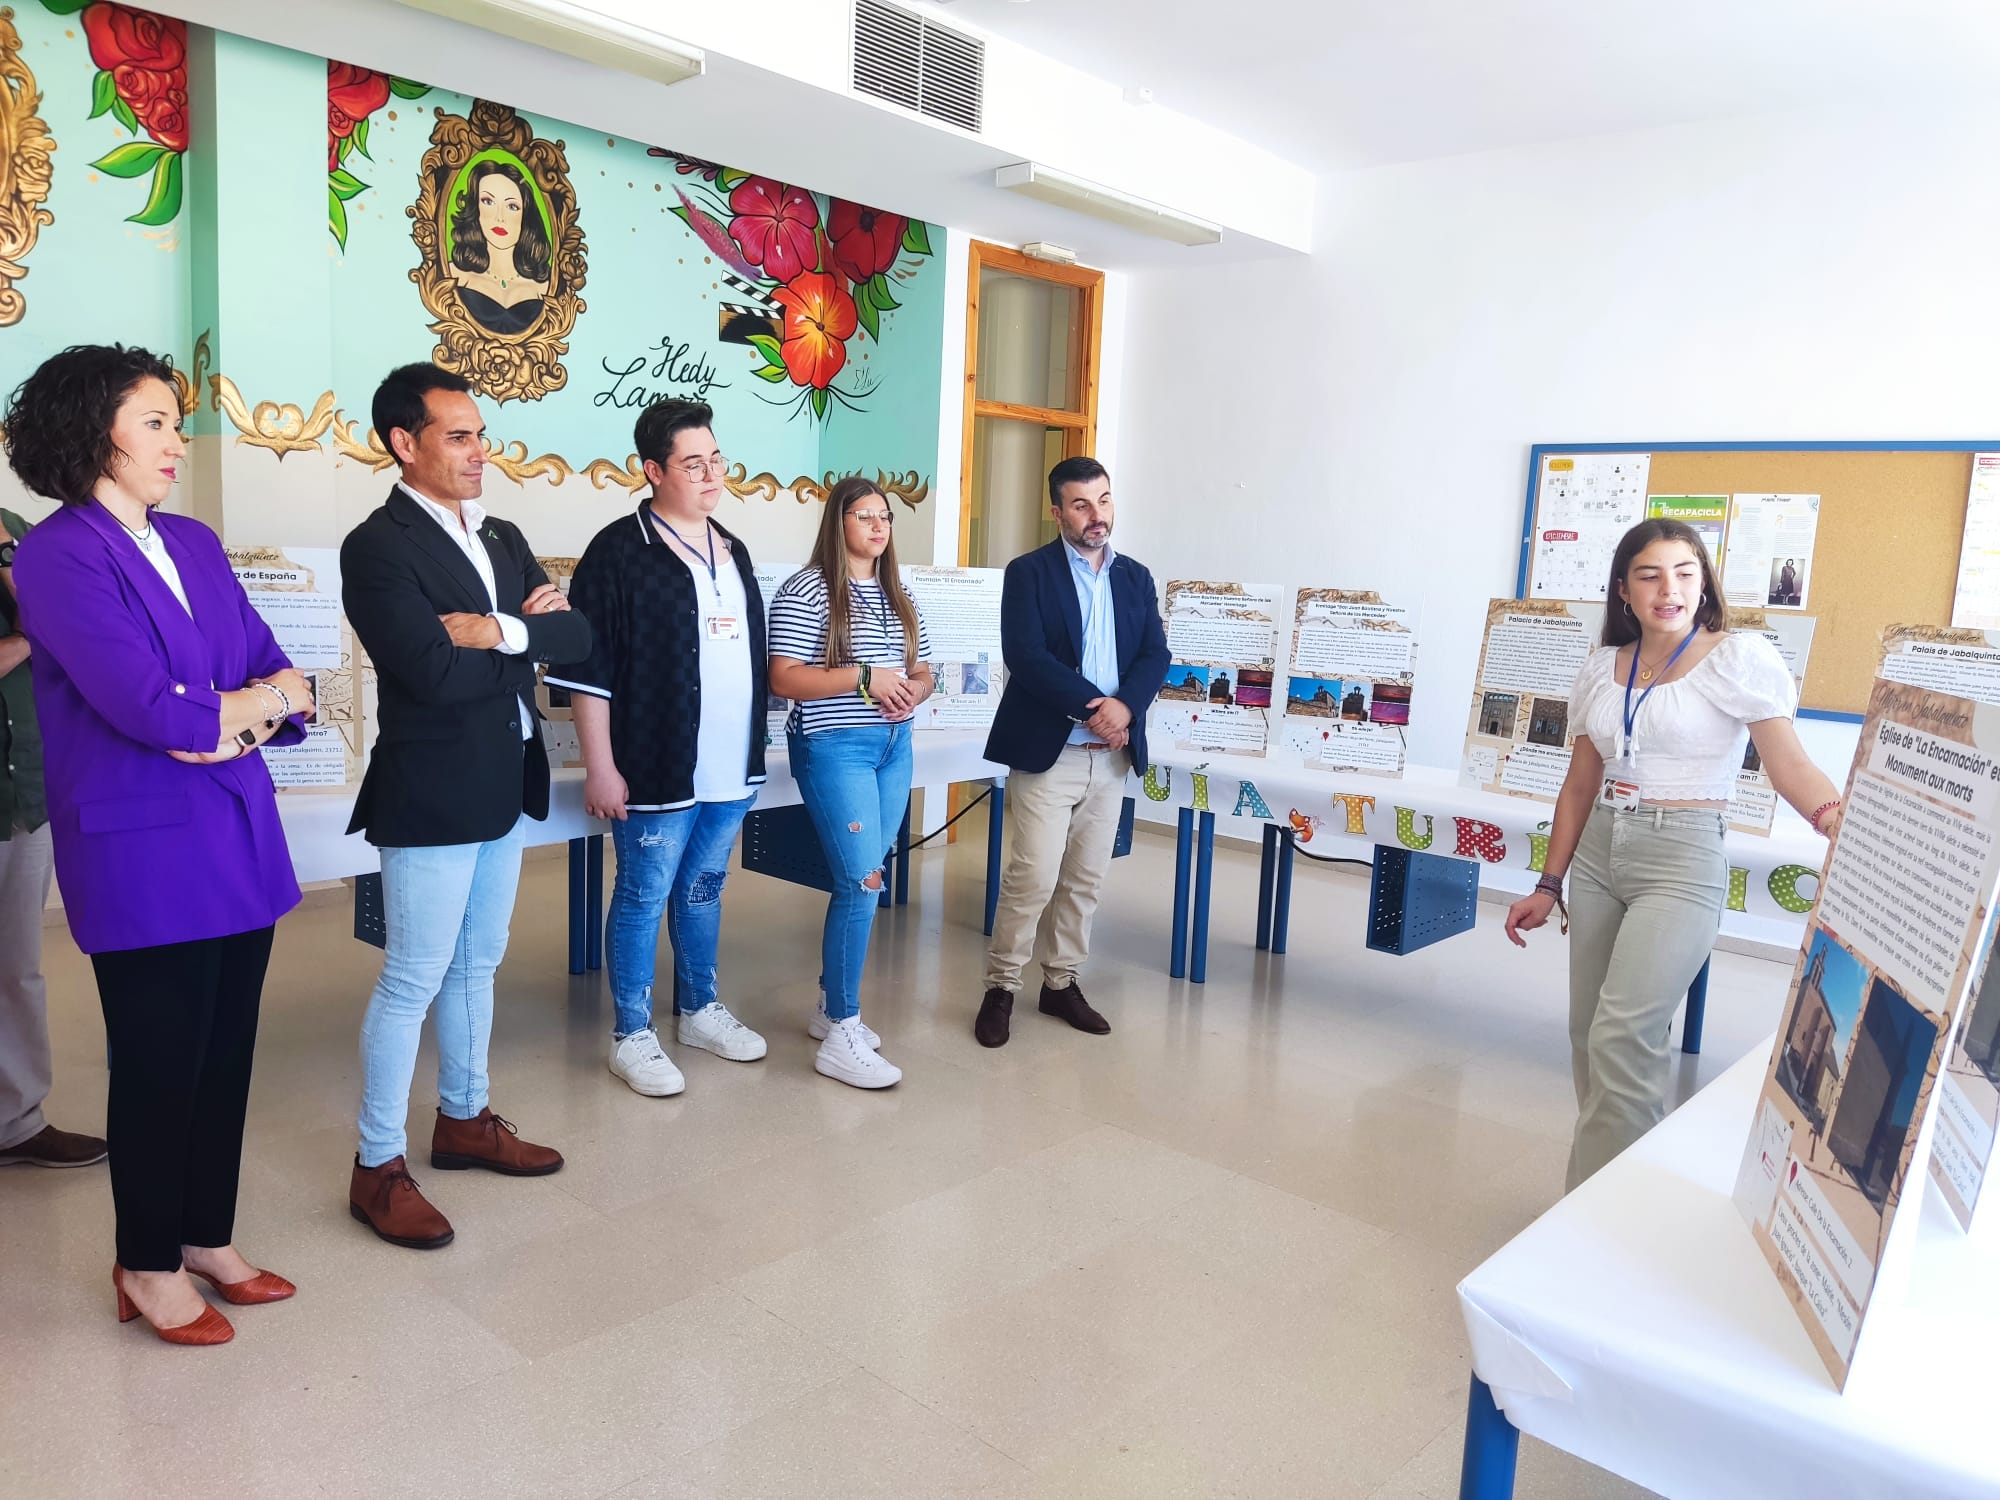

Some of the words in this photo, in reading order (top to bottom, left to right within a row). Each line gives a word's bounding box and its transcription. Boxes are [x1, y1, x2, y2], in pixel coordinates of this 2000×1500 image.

[649, 336, 732, 388] Hedy
[1662, 509, 1723, 517] RECAPACICLA
[259, 572, 297, 581] España
[1543, 618, 1583, 627] Jabalquinto
[1911, 645, 1936, 655] Palais
[1937, 648, 1948, 656] de
[1950, 648, 2000, 661] Jabalquinto
[1880, 722, 1901, 745] Église
[1902, 733, 1913, 749] de
[1916, 736, 1928, 755] "La
[1928, 742, 1991, 774] Encarnación"
[1143, 762, 1274, 819] UÍA
[1885, 755, 1928, 783] Monument
[1928, 774, 1945, 791] aux
[1945, 781, 1973, 802] morts
